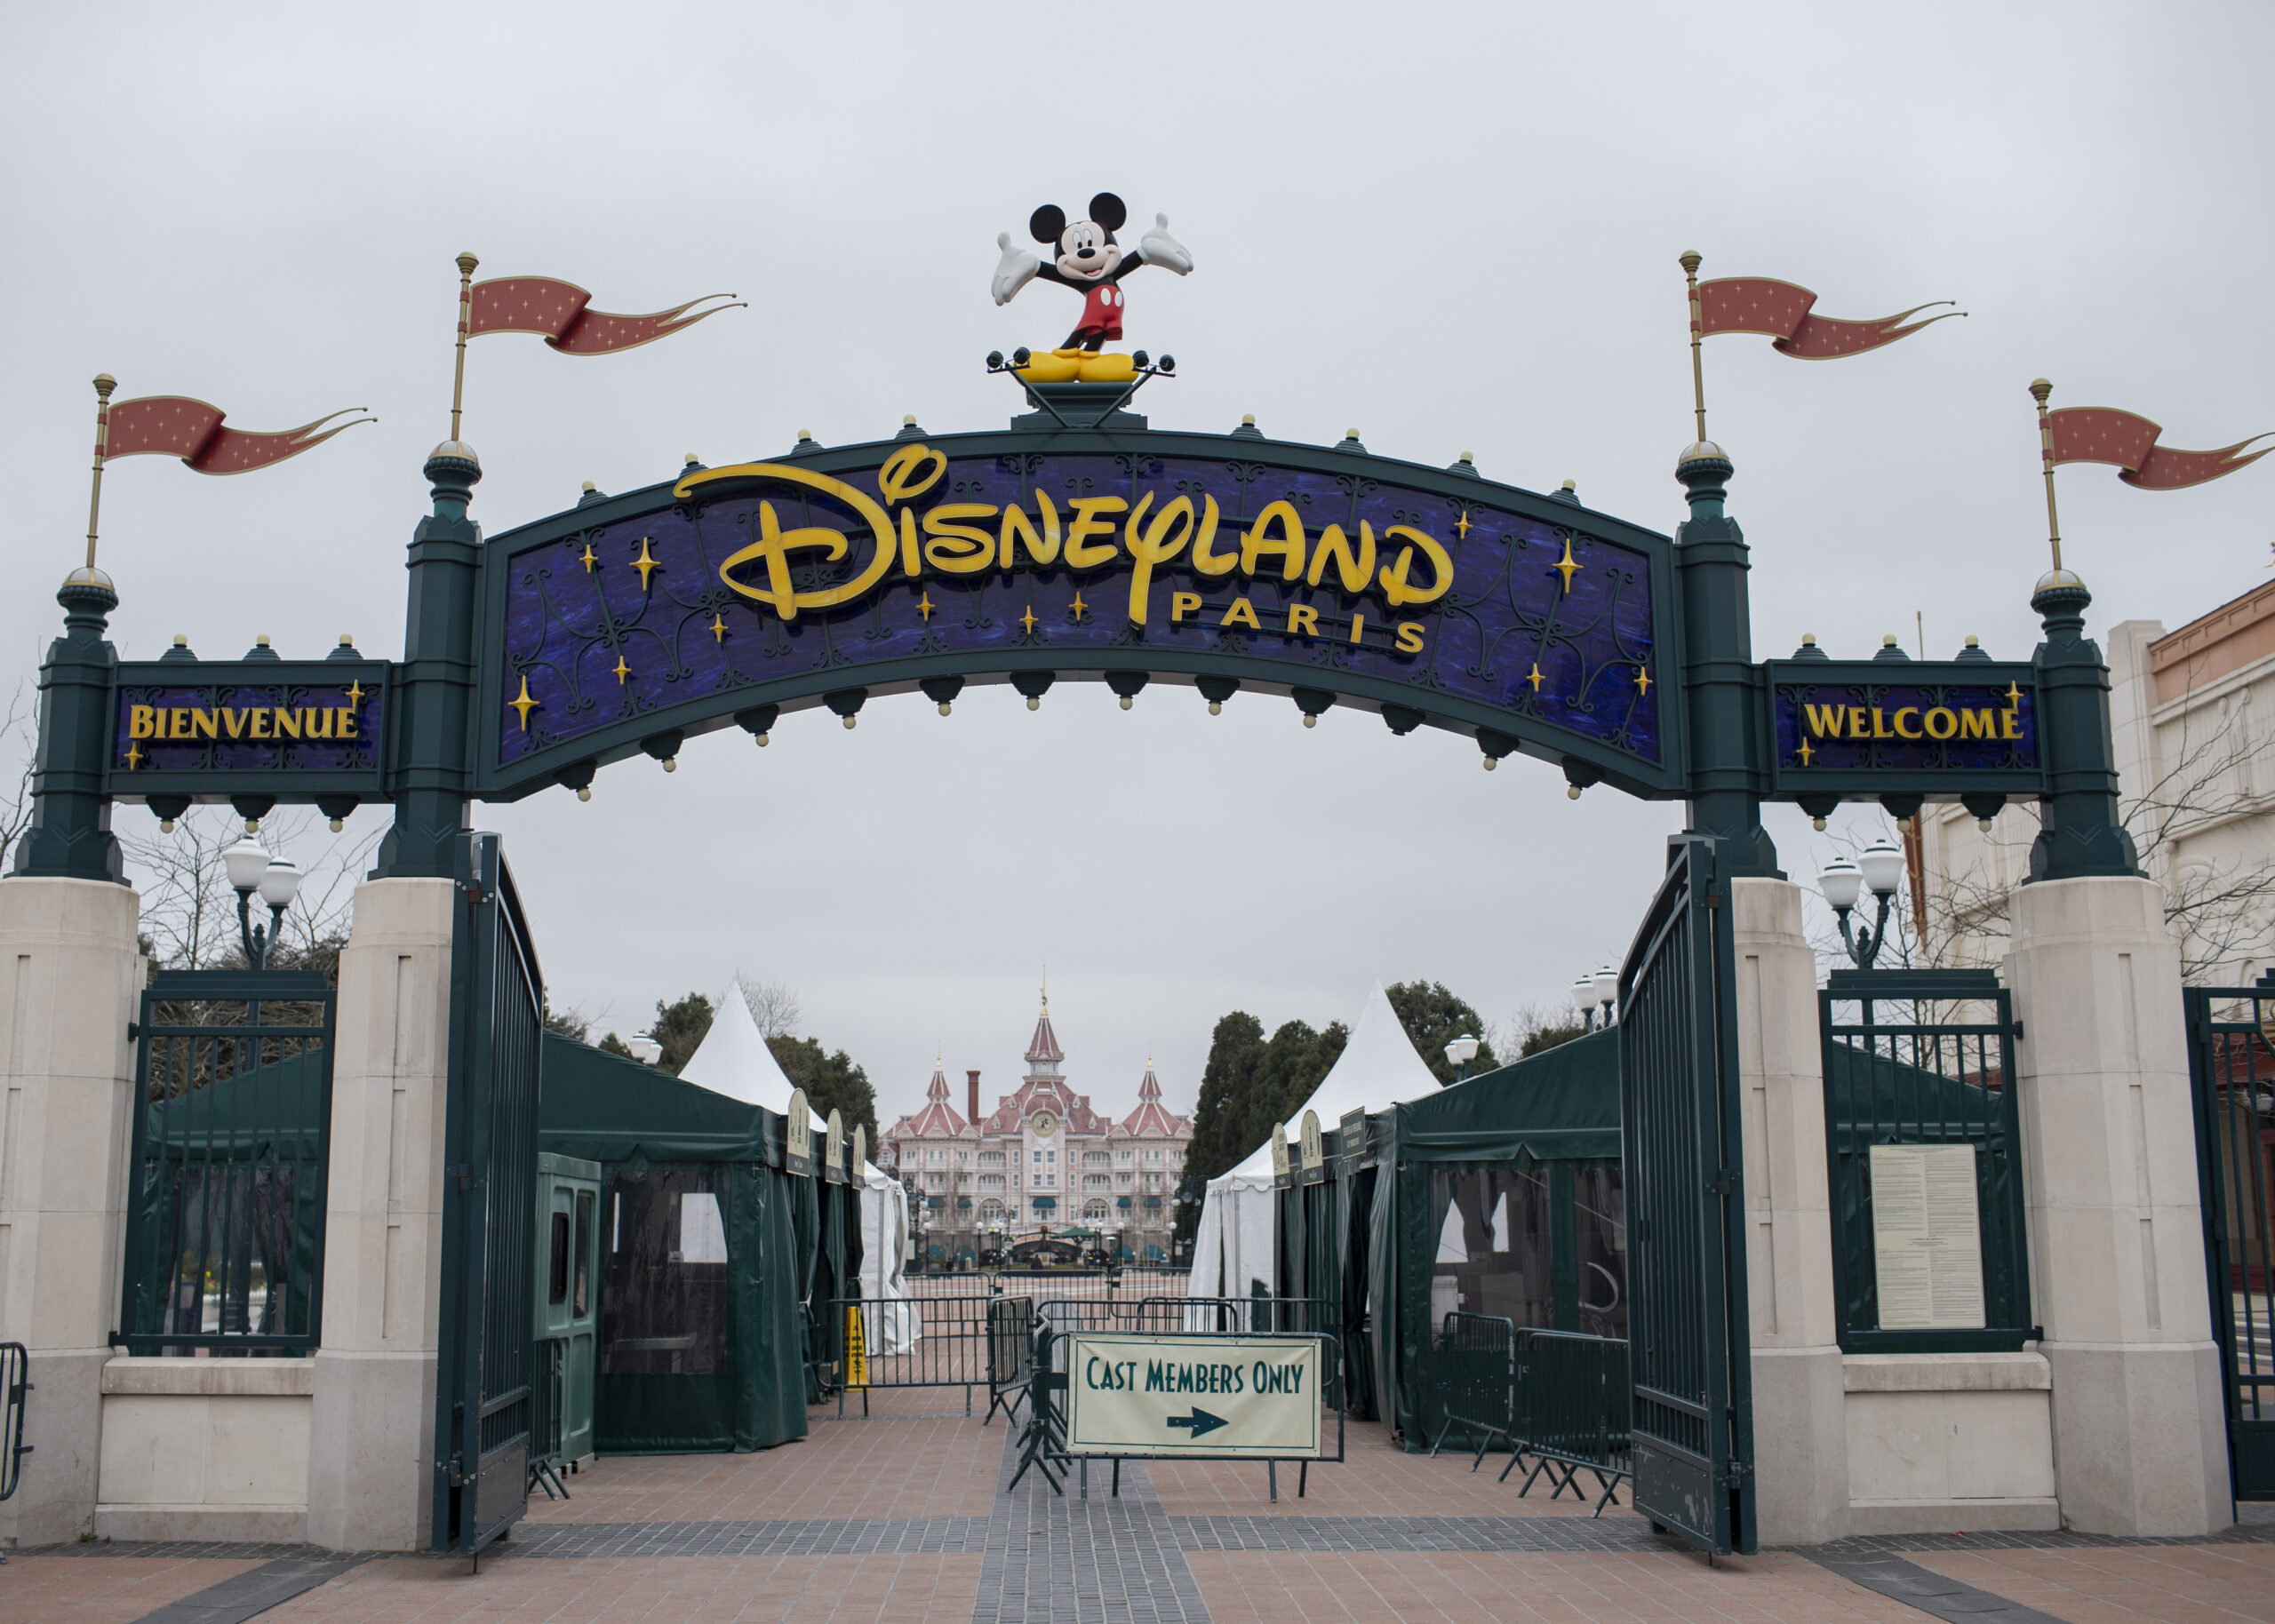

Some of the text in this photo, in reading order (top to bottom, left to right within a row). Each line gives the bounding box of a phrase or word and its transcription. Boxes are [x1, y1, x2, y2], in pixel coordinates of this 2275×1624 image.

[1170, 592, 1426, 656] PARIS
[128, 704, 359, 740] BIENVENUE
[1803, 704, 2024, 740] WELCOME
[1086, 1356, 1305, 1395] CAST MEMBERS ONLY
